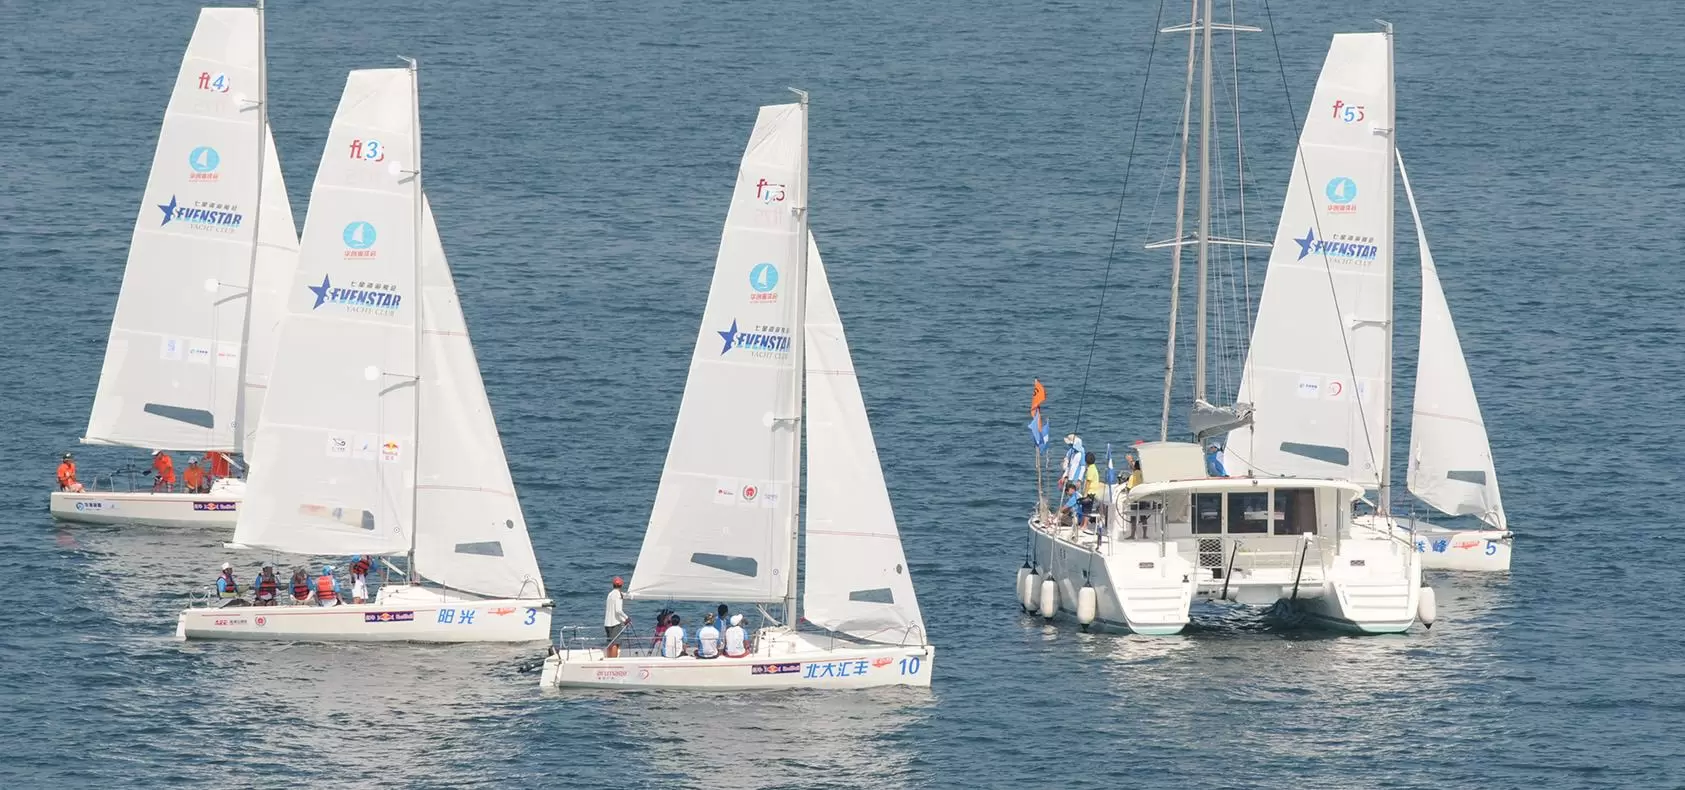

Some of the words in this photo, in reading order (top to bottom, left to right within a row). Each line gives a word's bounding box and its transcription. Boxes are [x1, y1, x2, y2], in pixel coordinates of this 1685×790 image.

[172, 207, 242, 225] SEVENSTAR
[1309, 240, 1377, 259] SEVENSTAR
[325, 287, 401, 308] SEVENSTAR
[1485, 540, 1496, 555] 5
[437, 608, 476, 624] 阳光
[524, 608, 537, 626] 3
[803, 661, 869, 679] 北大汇丰
[899, 656, 921, 675] 10
